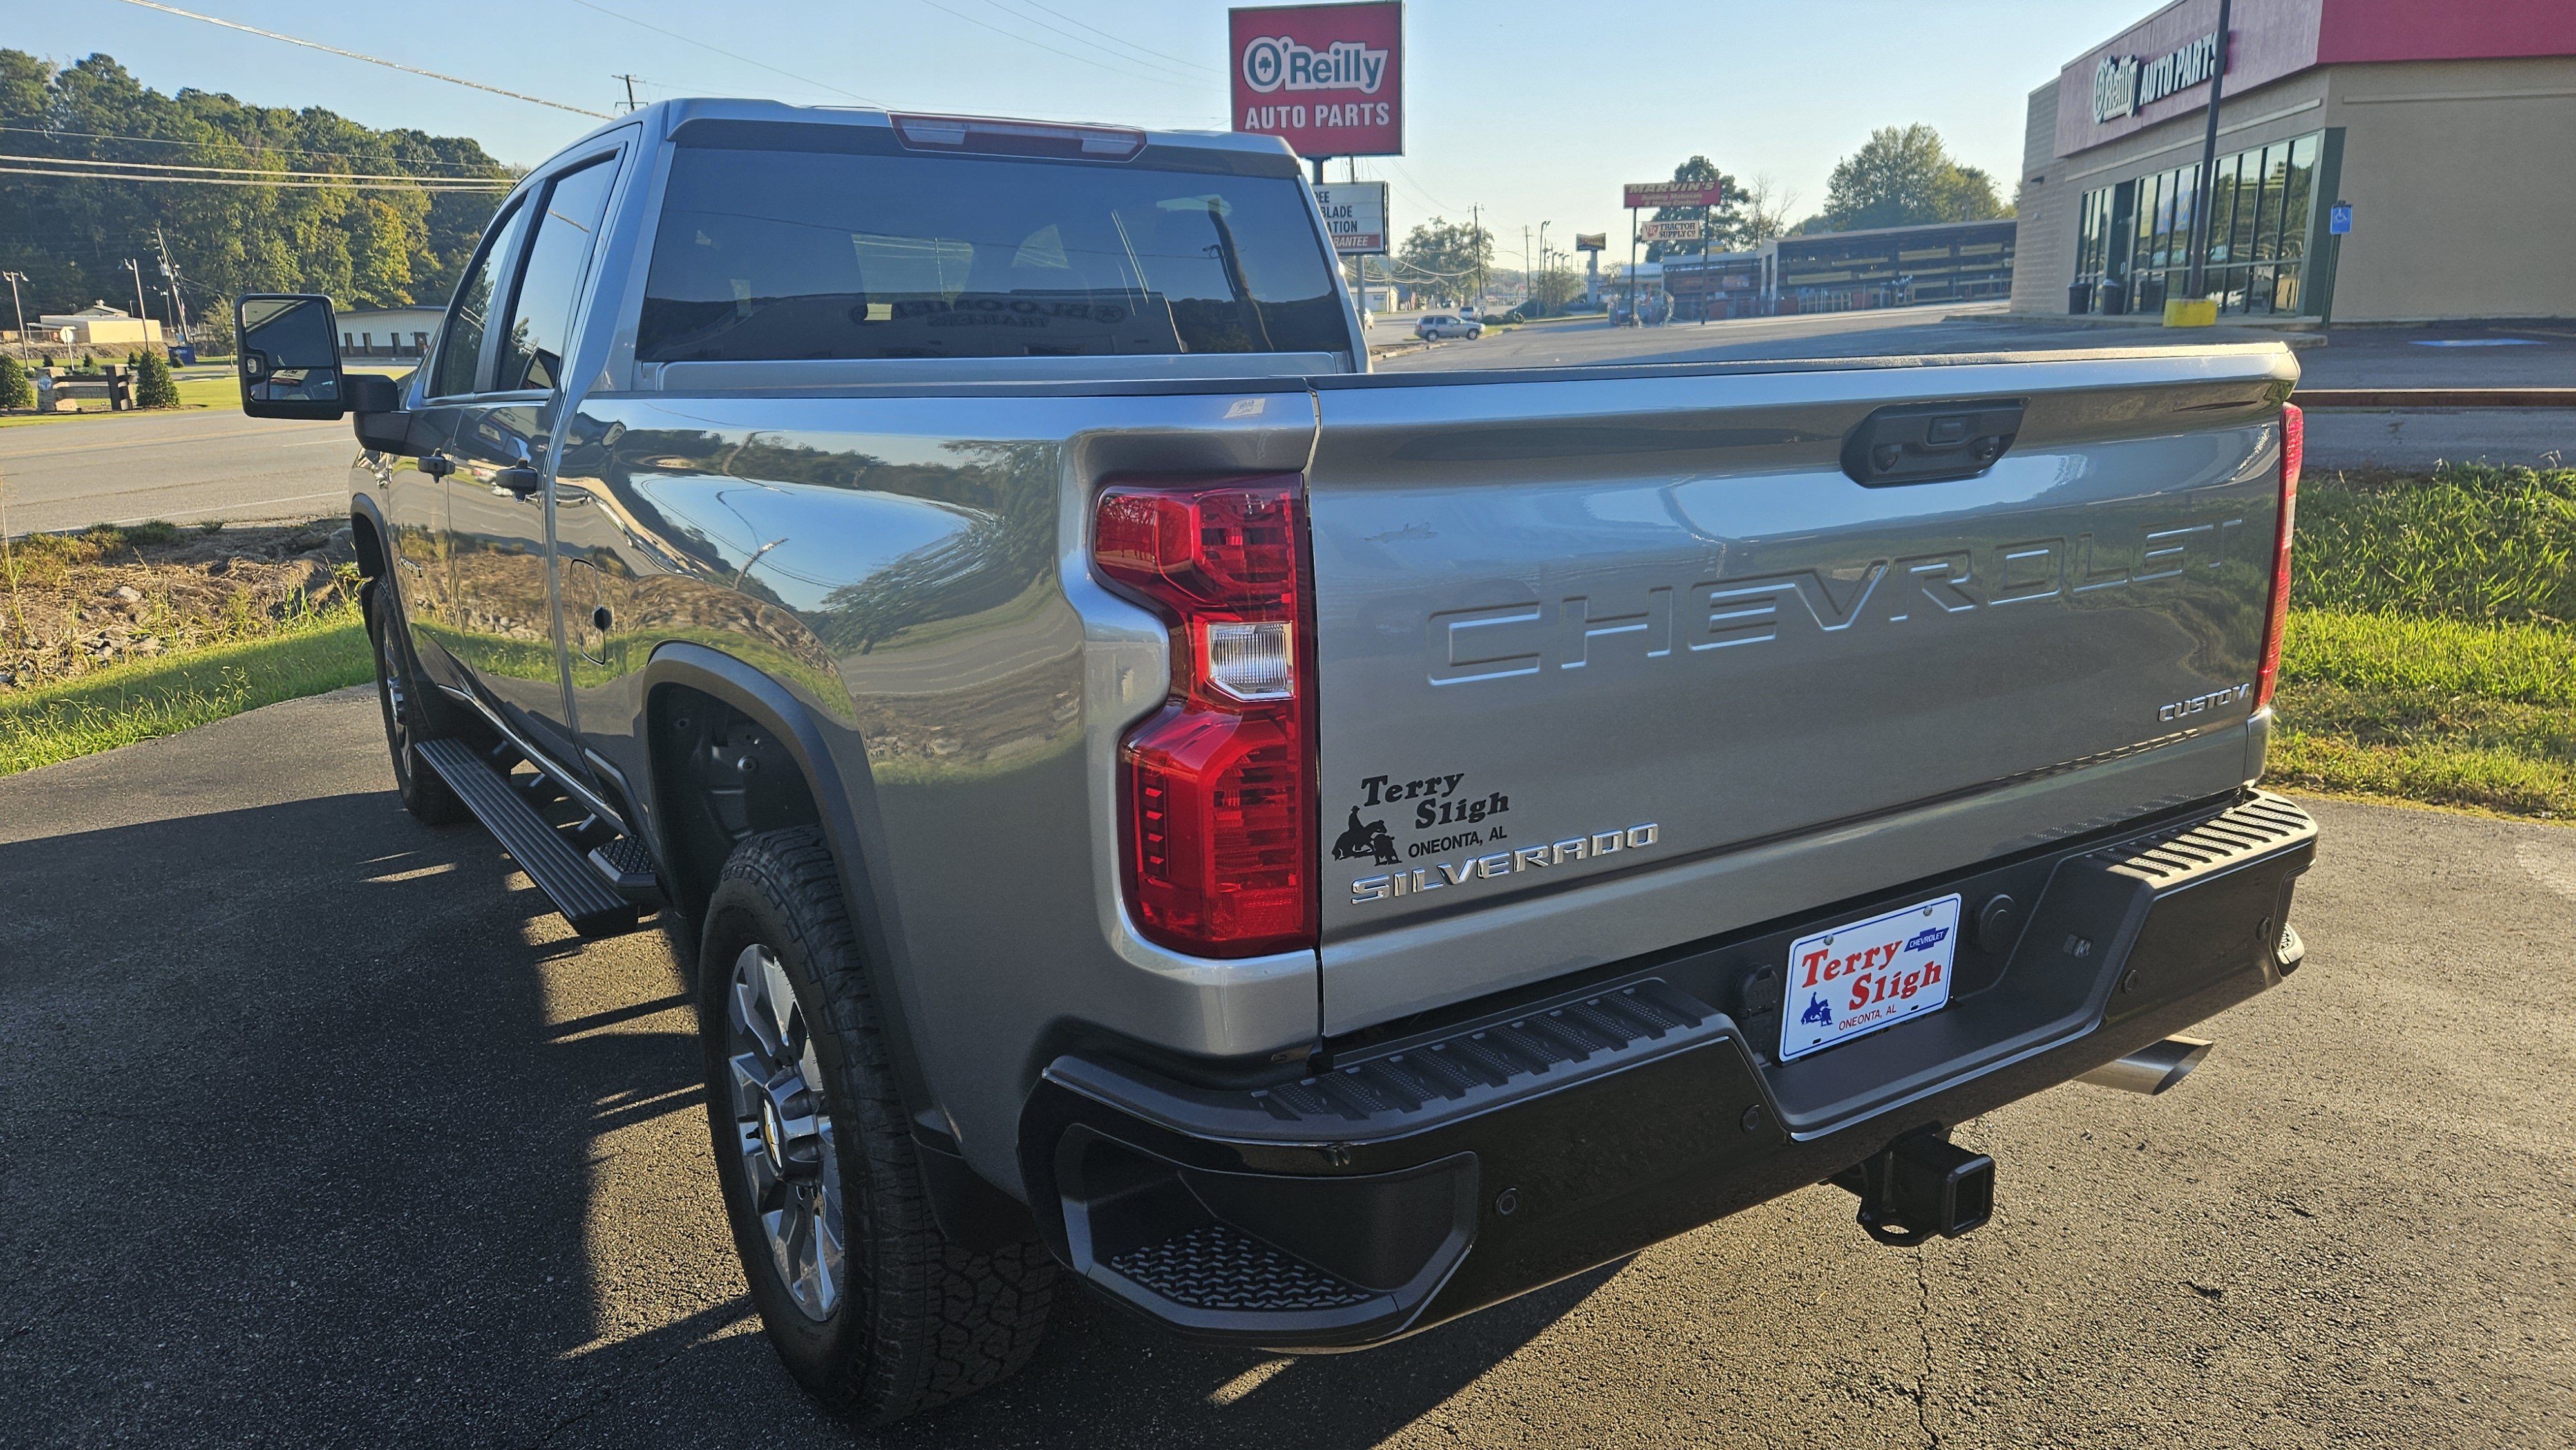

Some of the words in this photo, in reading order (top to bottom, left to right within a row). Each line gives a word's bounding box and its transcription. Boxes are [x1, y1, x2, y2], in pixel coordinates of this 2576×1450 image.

[1245, 40, 1383, 90] O'Reilly
[2094, 58, 2137, 120] O'Reilly
[2138, 52, 2174, 106] AUTO
[1245, 105, 1306, 130] AUTO
[1315, 102, 1390, 127] PARTS
[1628, 182, 1715, 193] MARVIN'S
[1321, 205, 1352, 218] BLADE
[1426, 518, 2244, 685] CHEVROLET
[2158, 683, 2250, 722] CUSTOM
[1361, 773, 1465, 807] Terry
[1414, 791, 1510, 829] Sligh
[1408, 831, 1483, 859] ONEONTA,
[1488, 825, 1508, 841] AL
[1351, 822, 1659, 904] SILVERADO
[1909, 930, 1944, 949] CHEVROLET
[1801, 939, 1902, 988] Terry
[1848, 961, 1942, 1011] Sligh
[1839, 1009, 1882, 1031] ONEONTA,
[1886, 1004, 1897, 1015] AL
